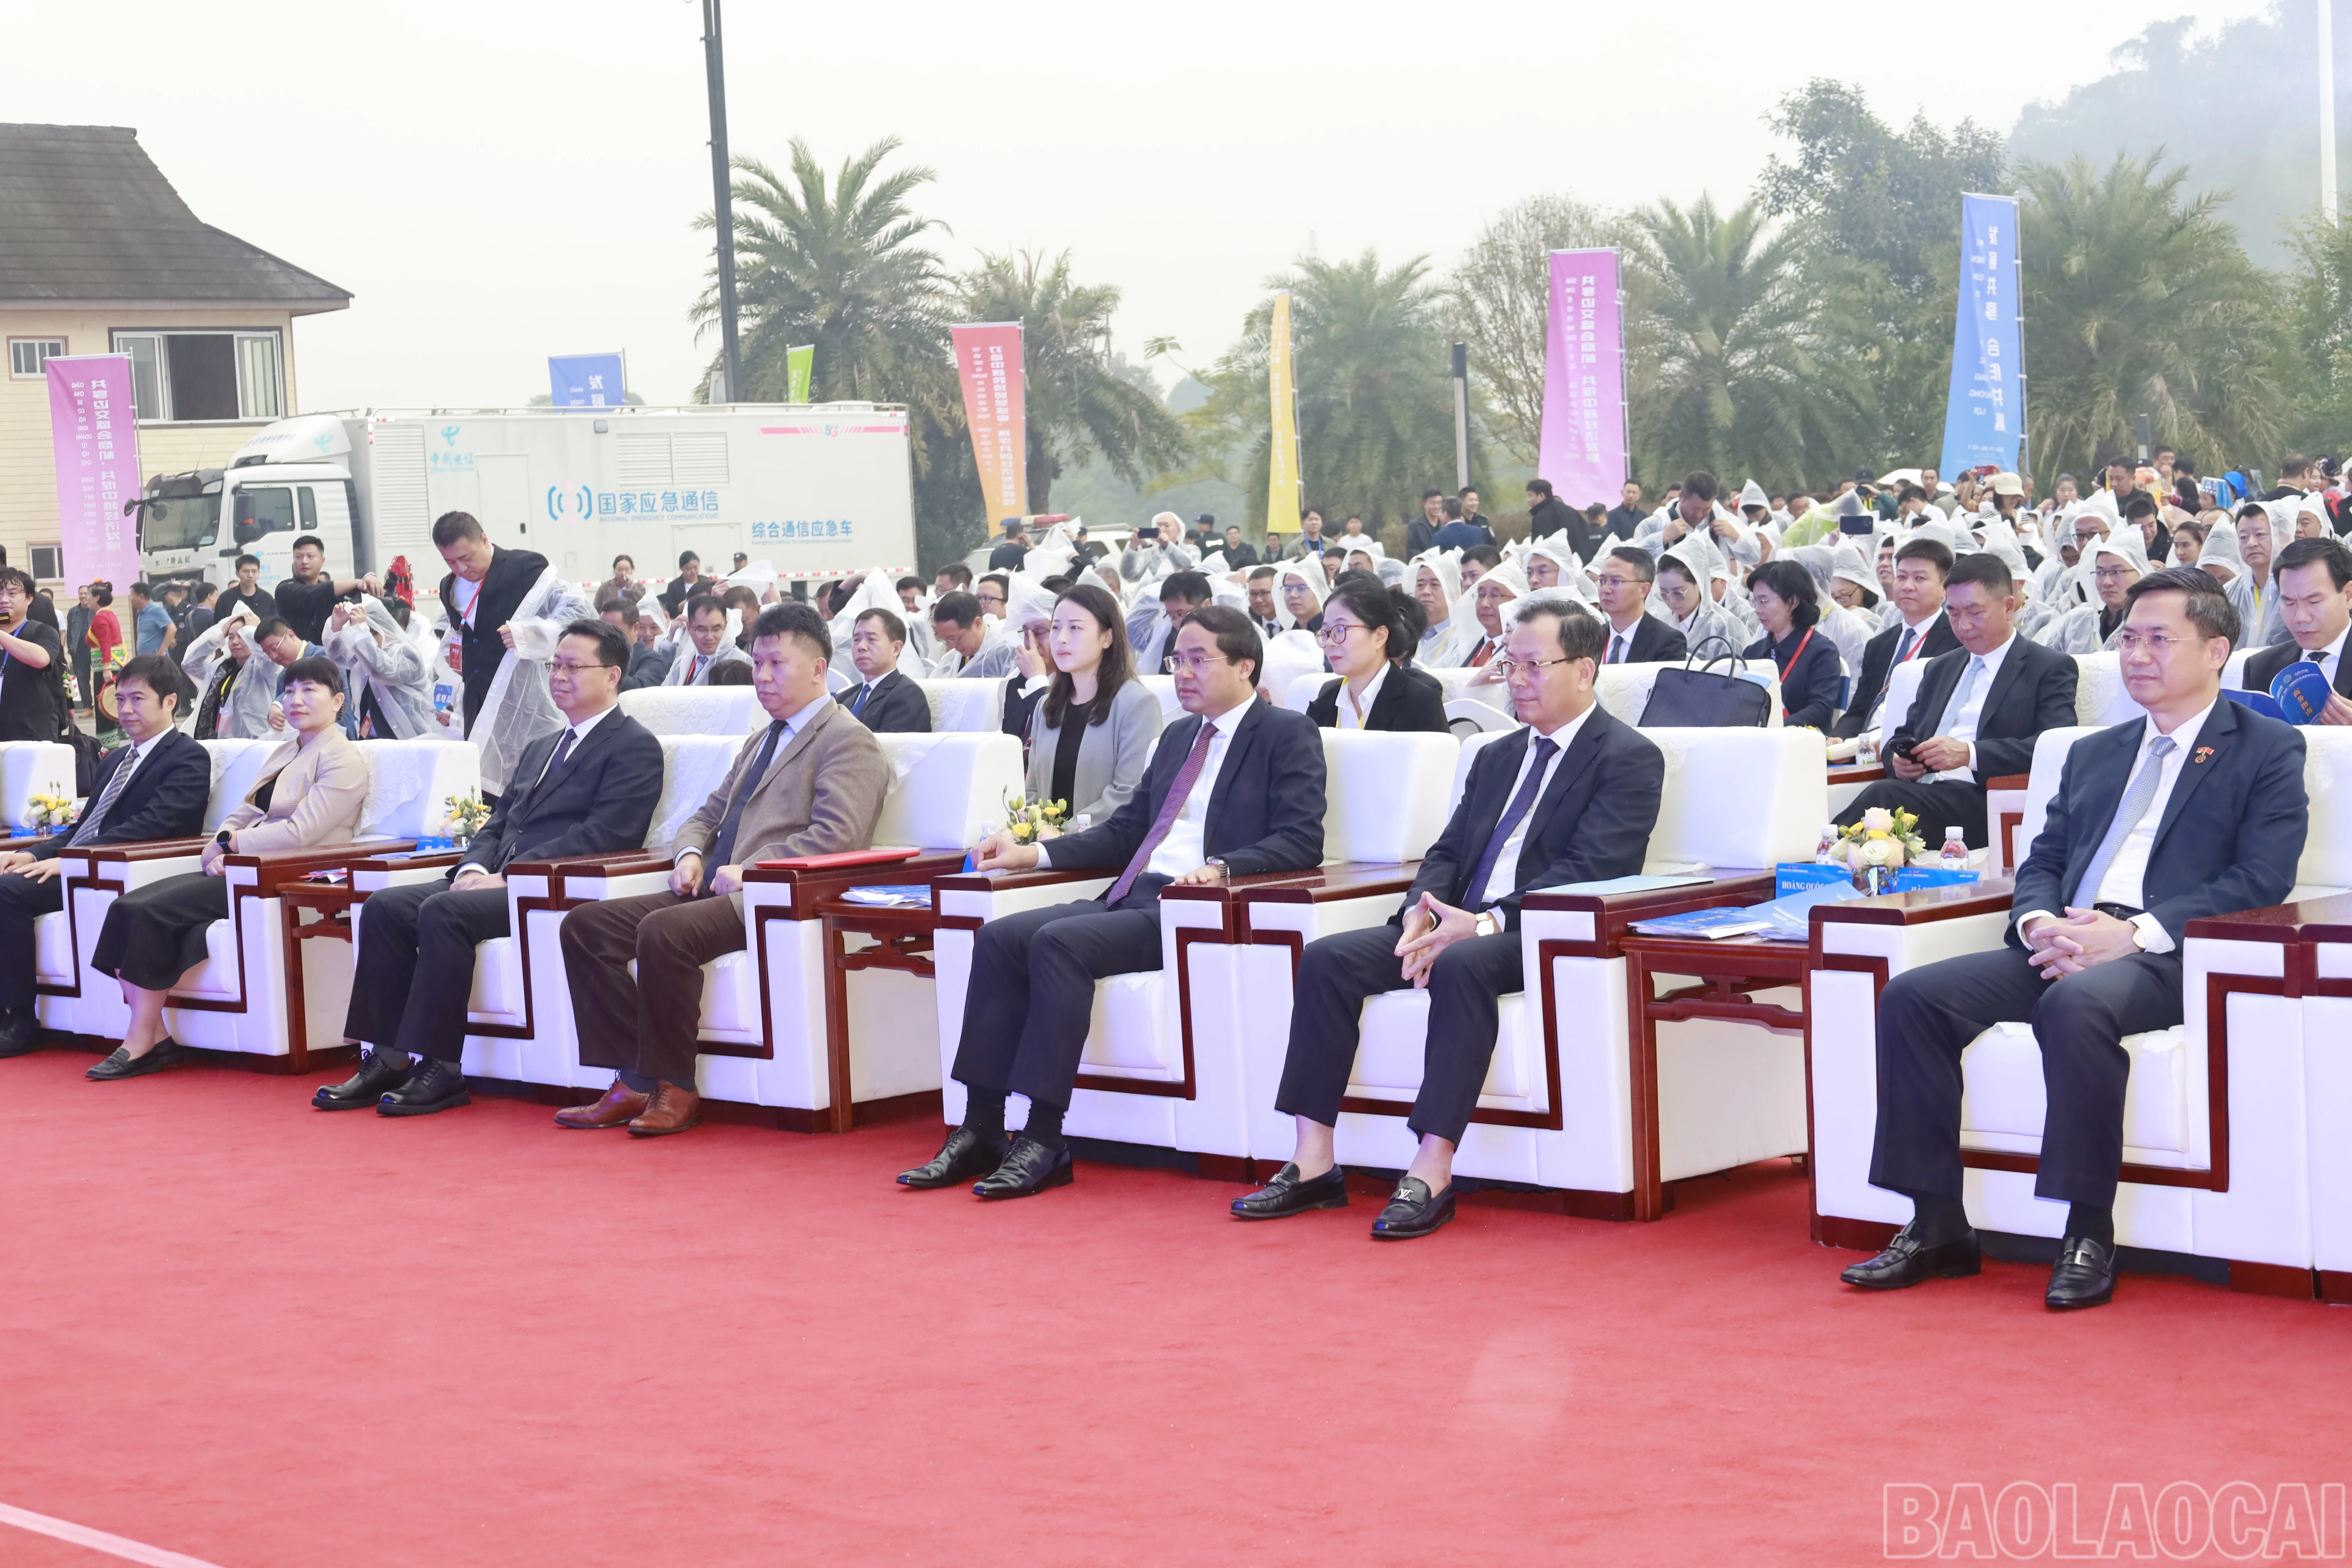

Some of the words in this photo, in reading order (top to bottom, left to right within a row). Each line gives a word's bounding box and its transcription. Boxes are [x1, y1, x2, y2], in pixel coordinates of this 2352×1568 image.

[430, 451, 474, 466] 中国电信
[598, 490, 718, 514] 国家应急通信
[752, 519, 853, 539] 综合通信应急车
[2293, 688, 2313, 716] 商务指南
[1782, 879, 1805, 890] HOÀNG
